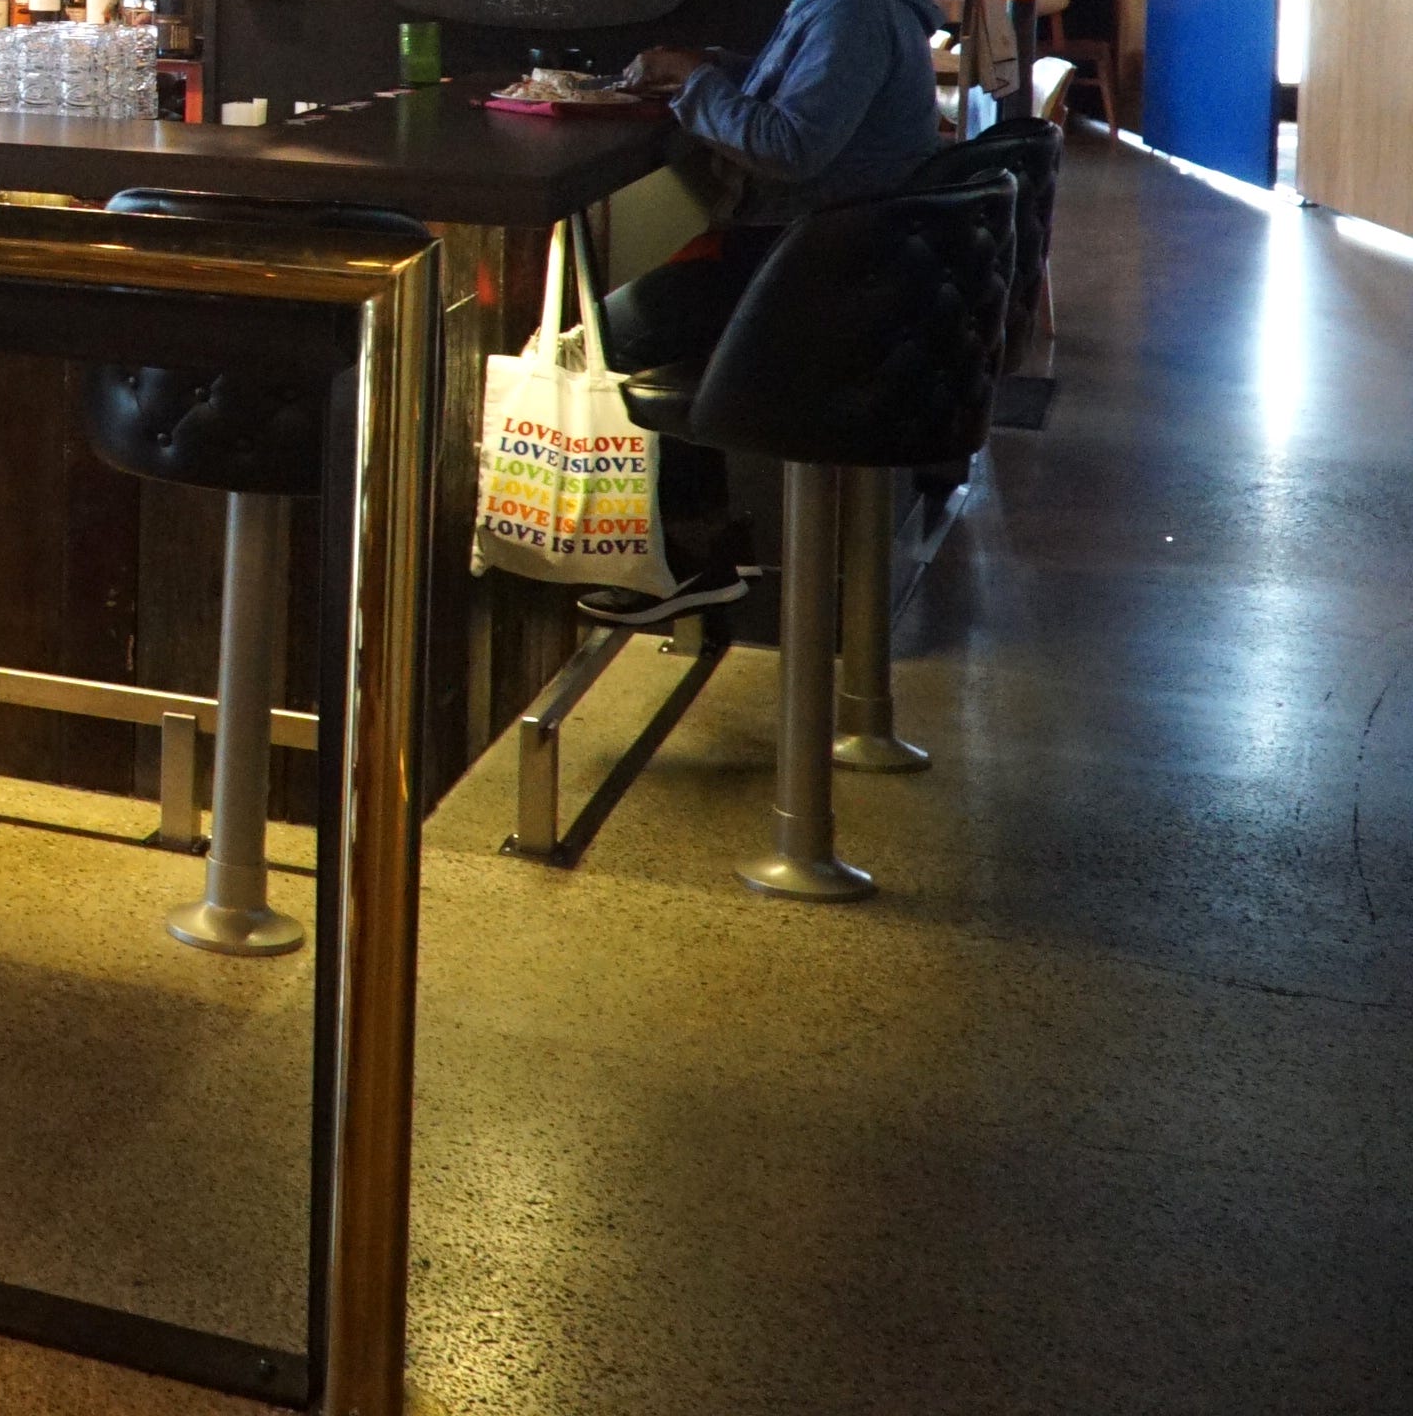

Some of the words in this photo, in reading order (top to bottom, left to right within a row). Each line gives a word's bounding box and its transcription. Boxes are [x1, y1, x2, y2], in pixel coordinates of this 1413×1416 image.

[500, 436, 558, 466] LOVE
[561, 456, 582, 473] IS
[582, 457, 646, 473] LOVE
[502, 417, 563, 447] LOVE
[564, 439, 582, 454] IS
[582, 436, 645, 453] LOVE
[494, 456, 555, 486] LOVE
[558, 476, 581, 494] IS
[582, 477, 646, 494] LOVE
[490, 476, 550, 505] LOVE
[557, 495, 578, 514] IS
[584, 498, 647, 515] LOVE
[486, 495, 550, 527] LOVE
[554, 516, 577, 534] IS
[583, 518, 649, 535] LOVE
[484, 515, 546, 548] LOVE
[551, 536, 575, 555] IS
[581, 539, 649, 555] LOVE
